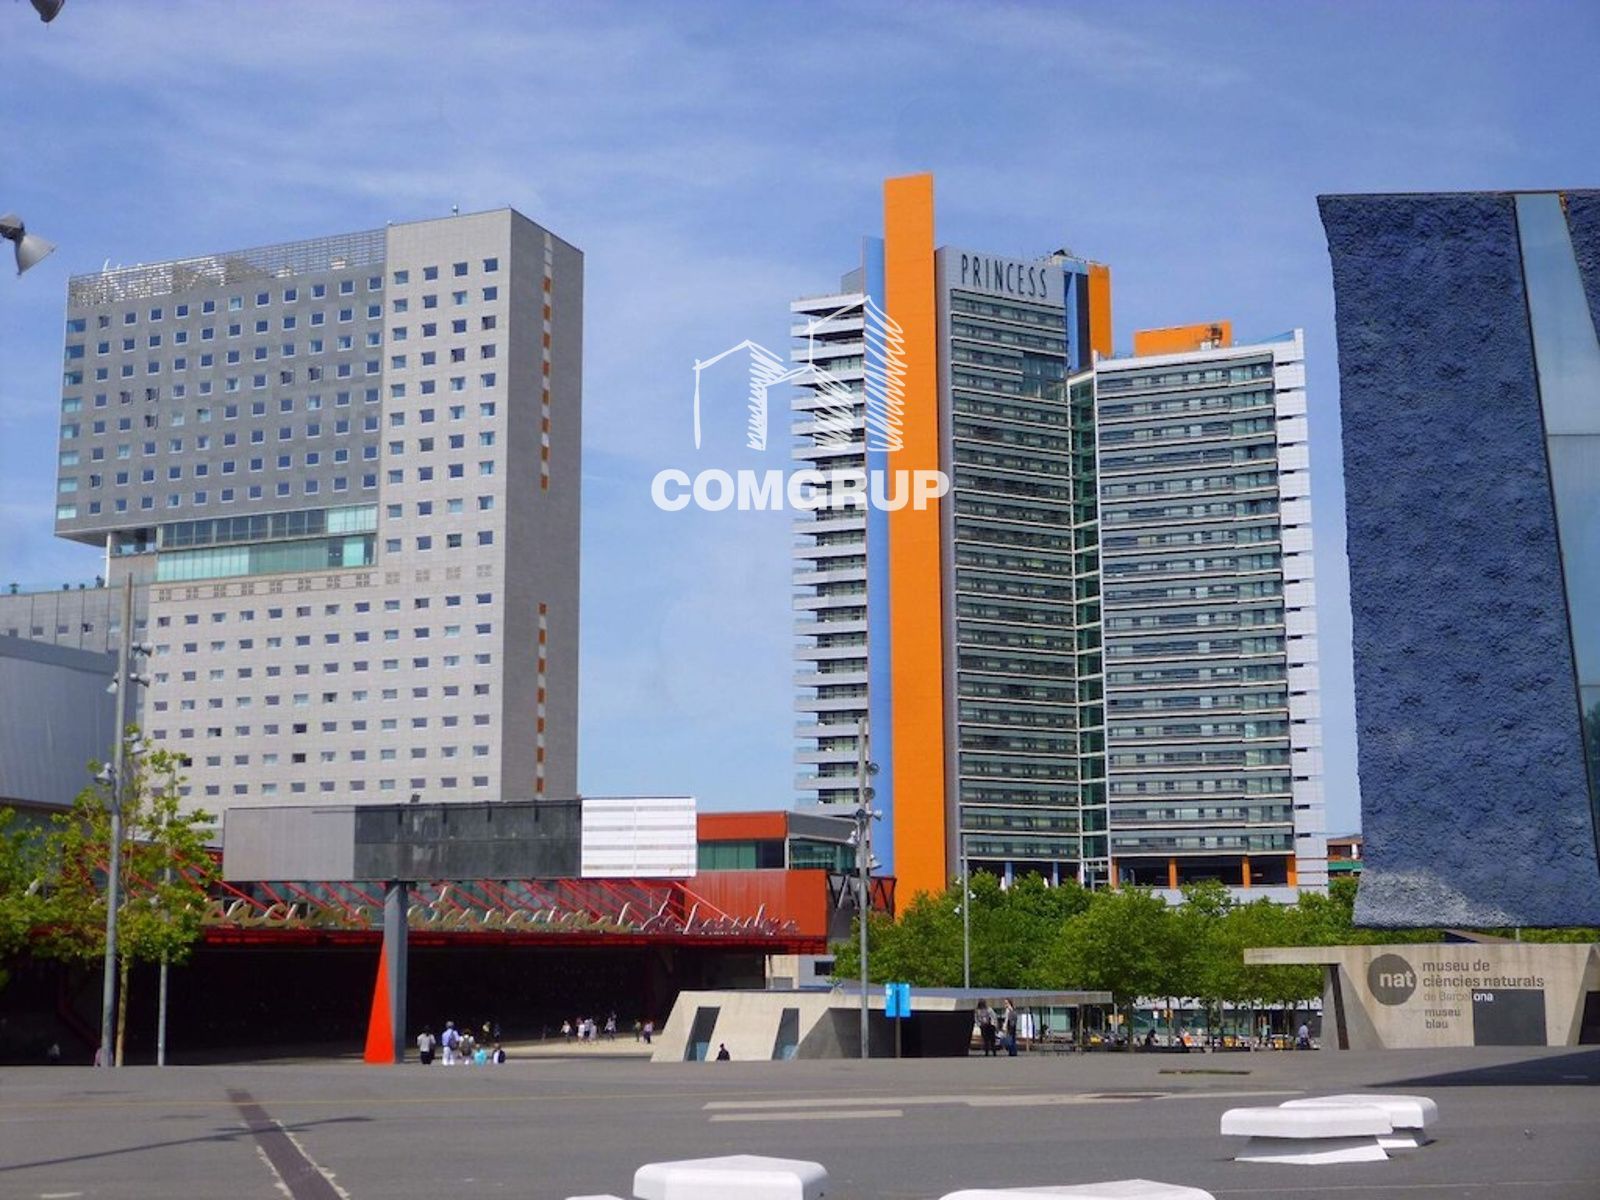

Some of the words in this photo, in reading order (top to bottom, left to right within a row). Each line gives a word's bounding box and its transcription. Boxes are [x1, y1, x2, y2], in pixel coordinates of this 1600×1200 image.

[962, 253, 1048, 298] PRINCESS
[1422, 961, 1469, 972] museu
[1473, 959, 1490, 972] de
[1380, 971, 1415, 988] nat
[1484, 976, 1545, 988] naturals
[1425, 1009, 1461, 1017] museu
[1426, 1018, 1449, 1029] blau
